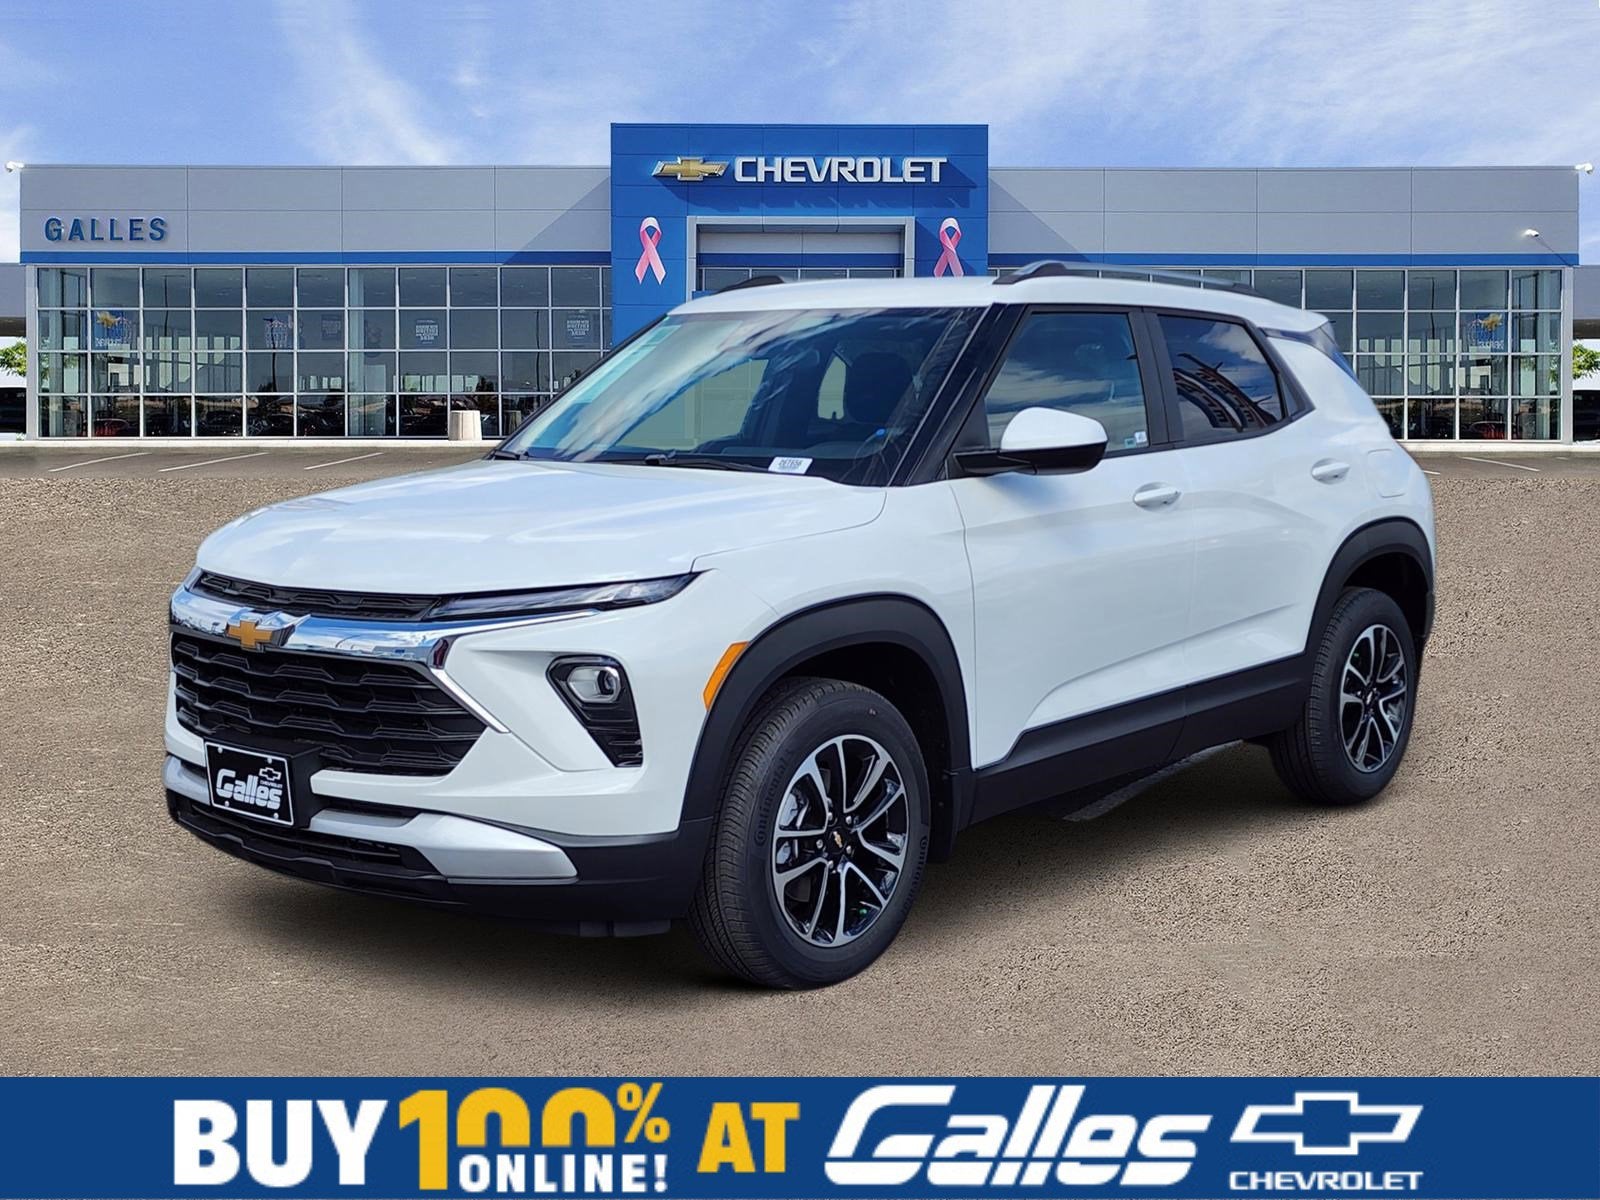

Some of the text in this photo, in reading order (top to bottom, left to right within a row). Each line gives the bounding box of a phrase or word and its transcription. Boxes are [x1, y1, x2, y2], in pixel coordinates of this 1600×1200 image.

[735, 156, 947, 183] CHEVROLET
[44, 217, 166, 242] GALLES
[216, 769, 283, 810] Galles
